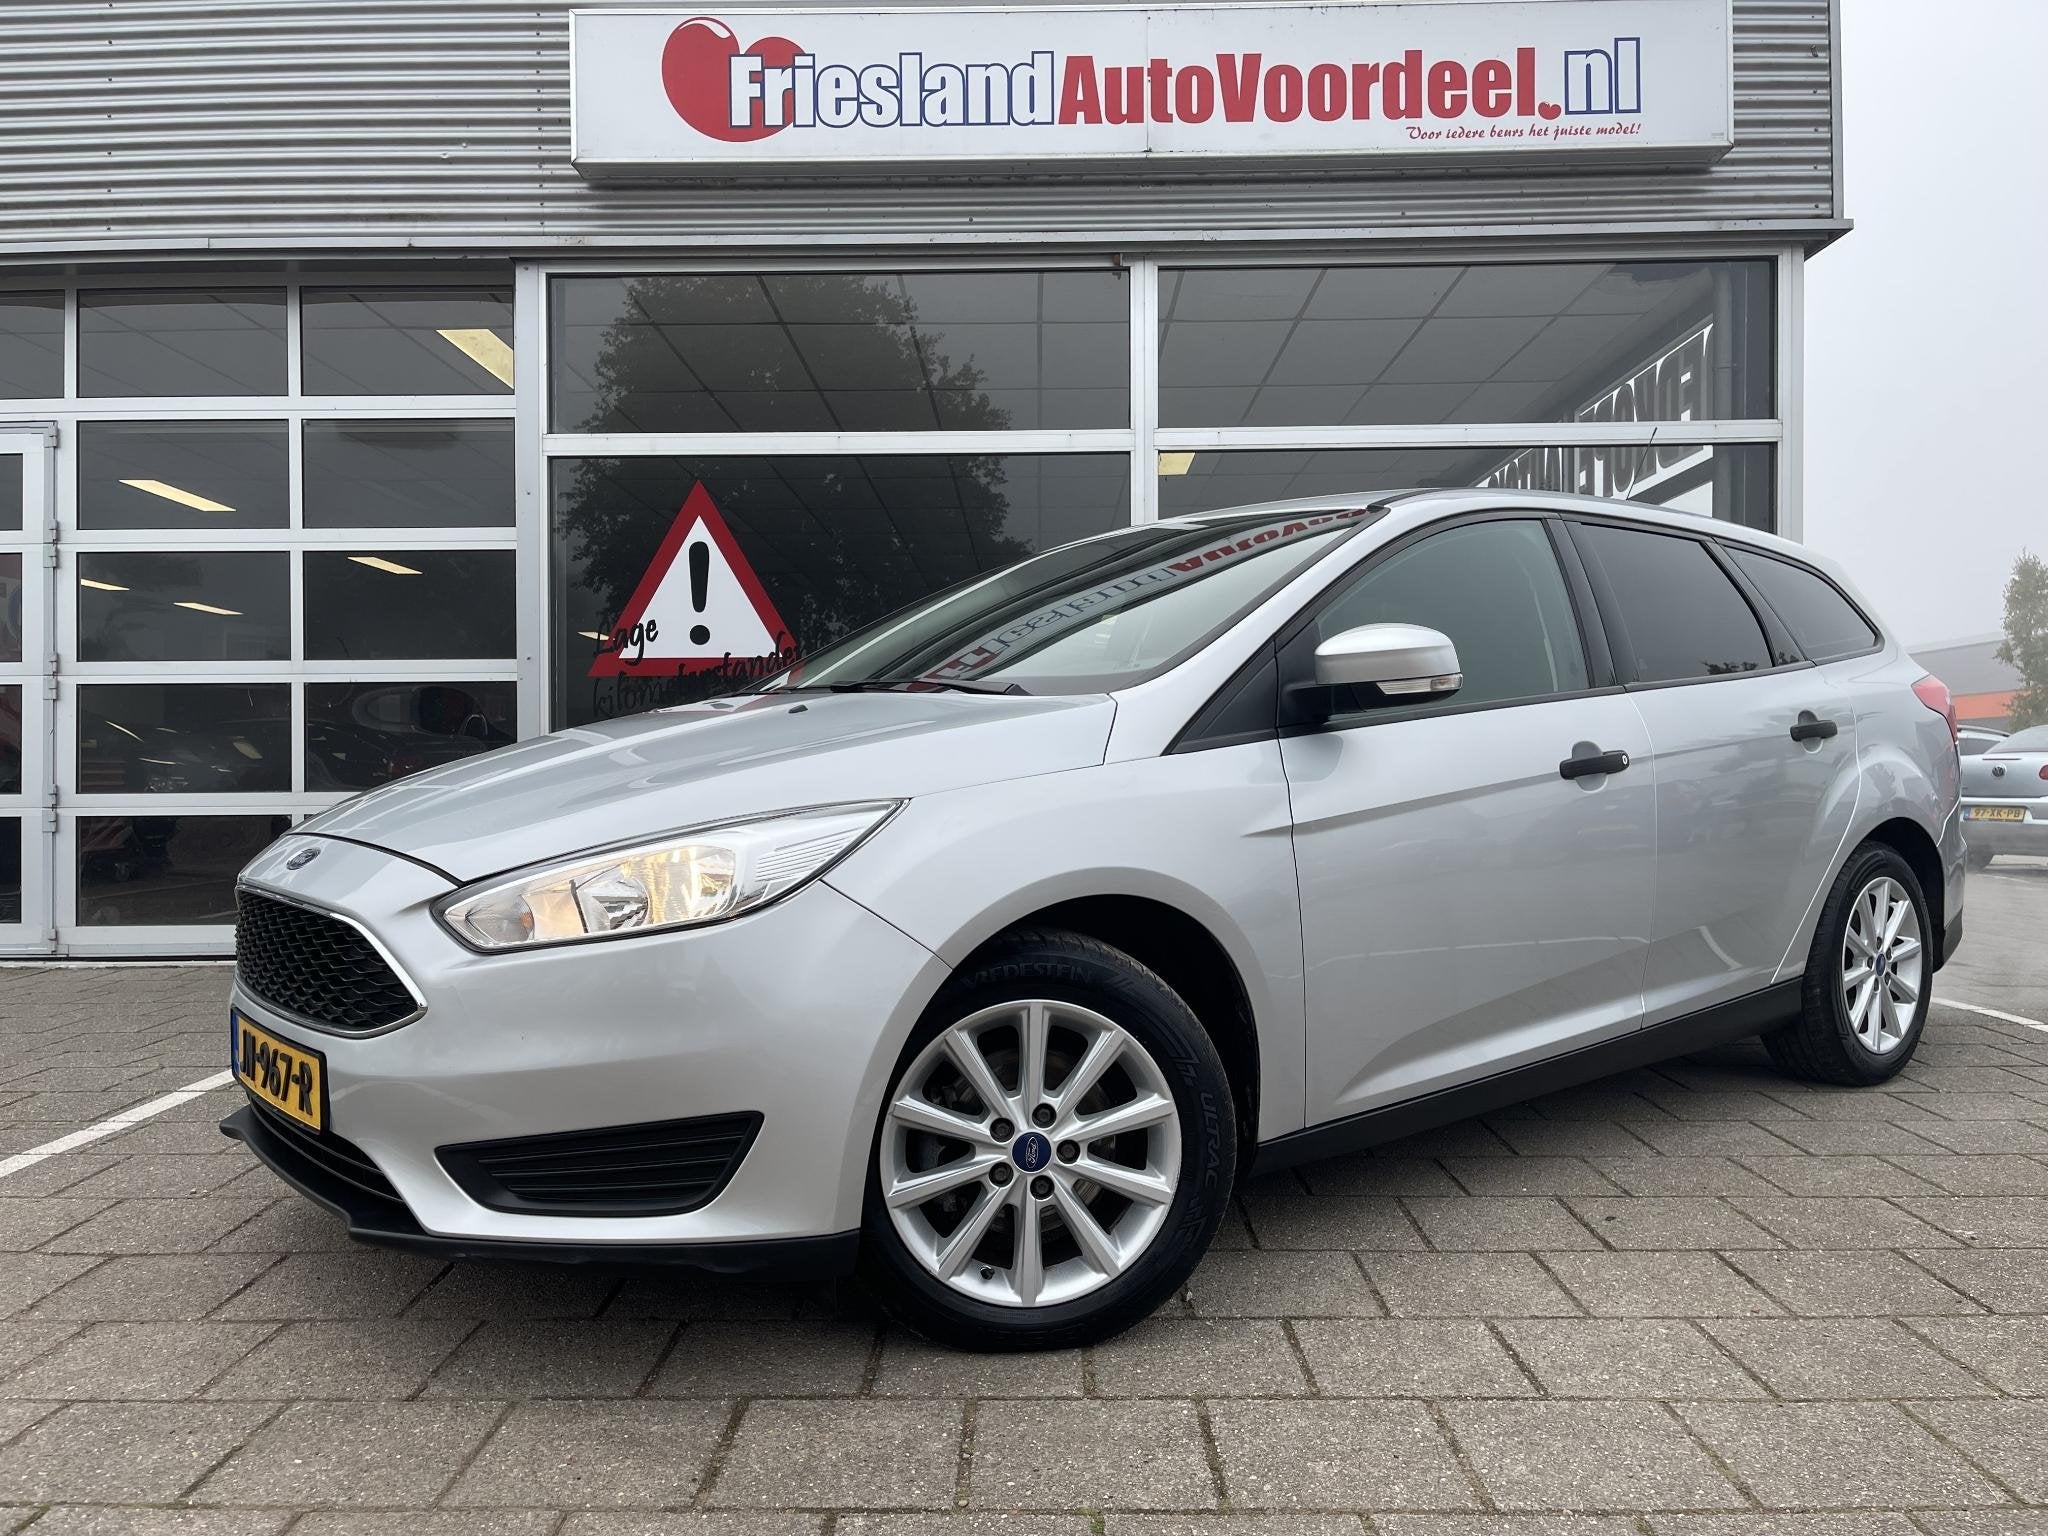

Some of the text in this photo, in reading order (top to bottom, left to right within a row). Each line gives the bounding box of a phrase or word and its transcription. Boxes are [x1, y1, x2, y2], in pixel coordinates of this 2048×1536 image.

[1406, 122, 1641, 141] Voor iedere beurs het juiste model!
[593, 618, 659, 666] Lage
[1026, 1141, 1037, 1164] Ford
[1199, 1091, 1220, 1187] ULTRAC
